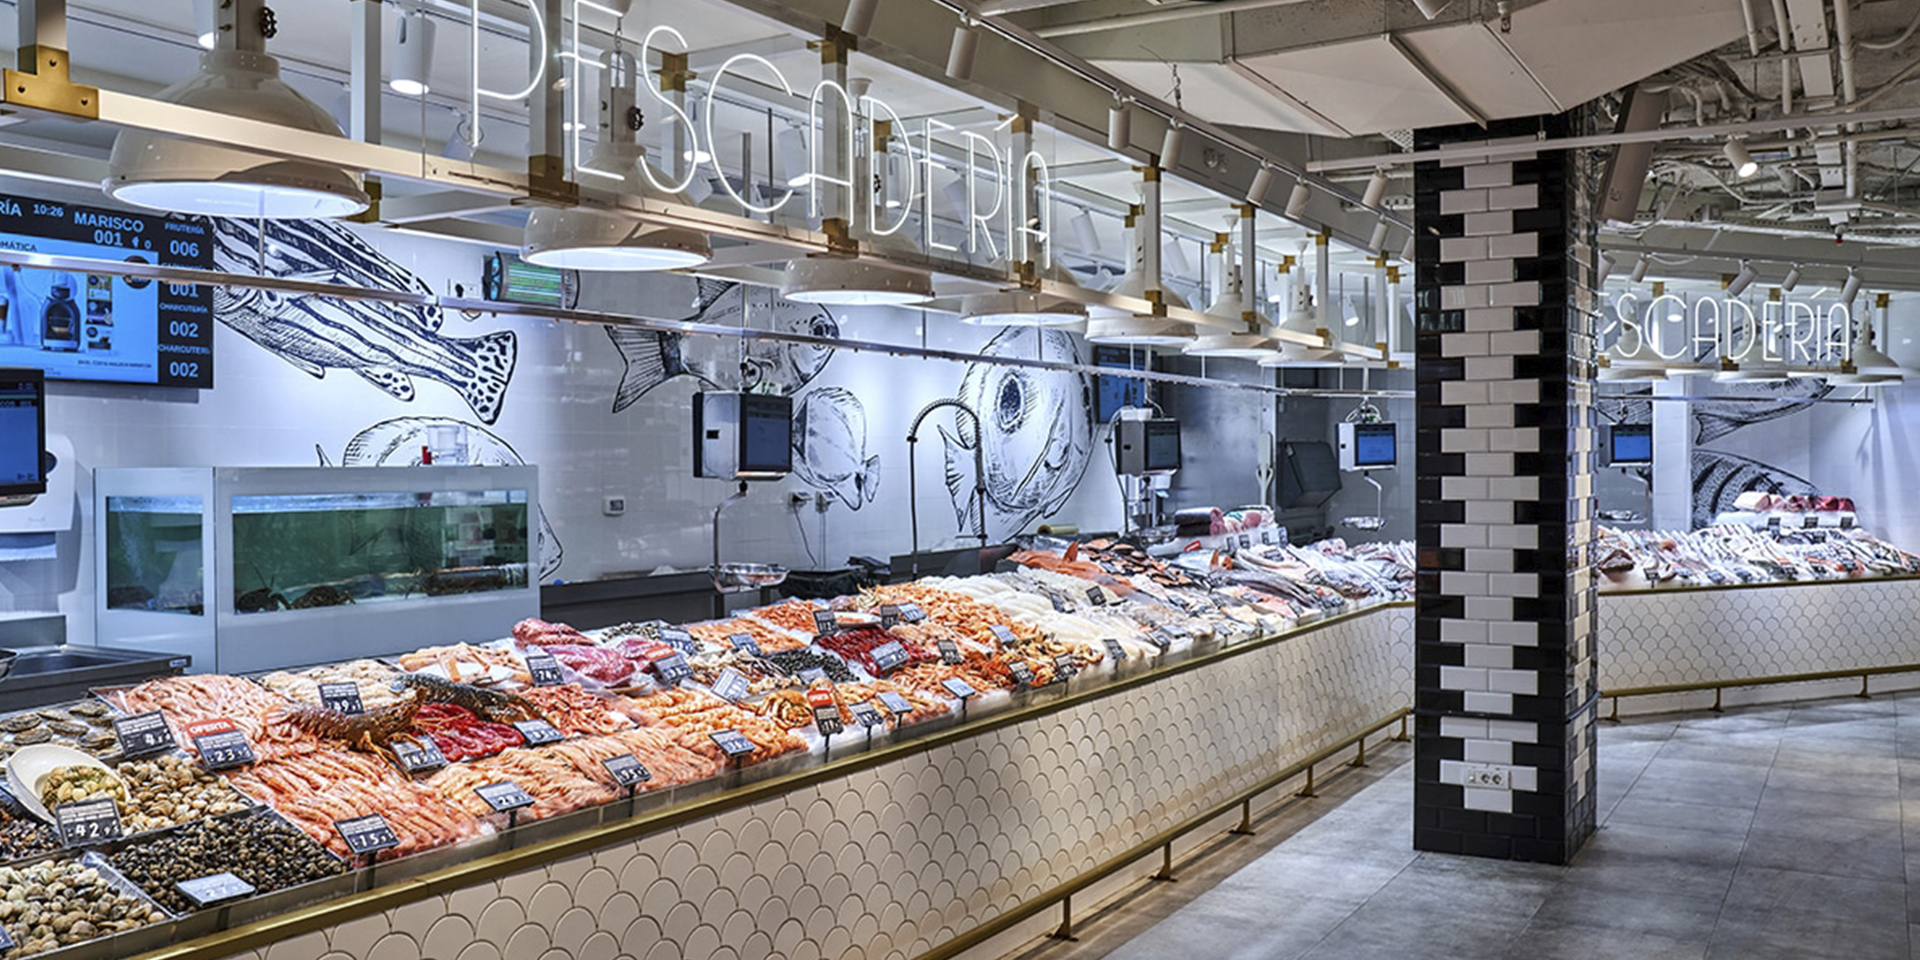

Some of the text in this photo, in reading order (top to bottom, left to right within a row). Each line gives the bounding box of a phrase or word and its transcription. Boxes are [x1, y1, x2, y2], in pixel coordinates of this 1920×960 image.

[472, 0, 1051, 269] PESCADERÍA
[33, 203, 64, 218] 10:26
[74, 211, 144, 233] MARISCO
[94, 229, 123, 246] 001
[164, 222, 205, 235] FRUTERÍA
[169, 239, 199, 258] 006
[169, 281, 199, 298] 001
[169, 320, 199, 338] 002
[1597, 287, 1850, 362] SCADERÍA
[169, 361, 199, 378] 002
